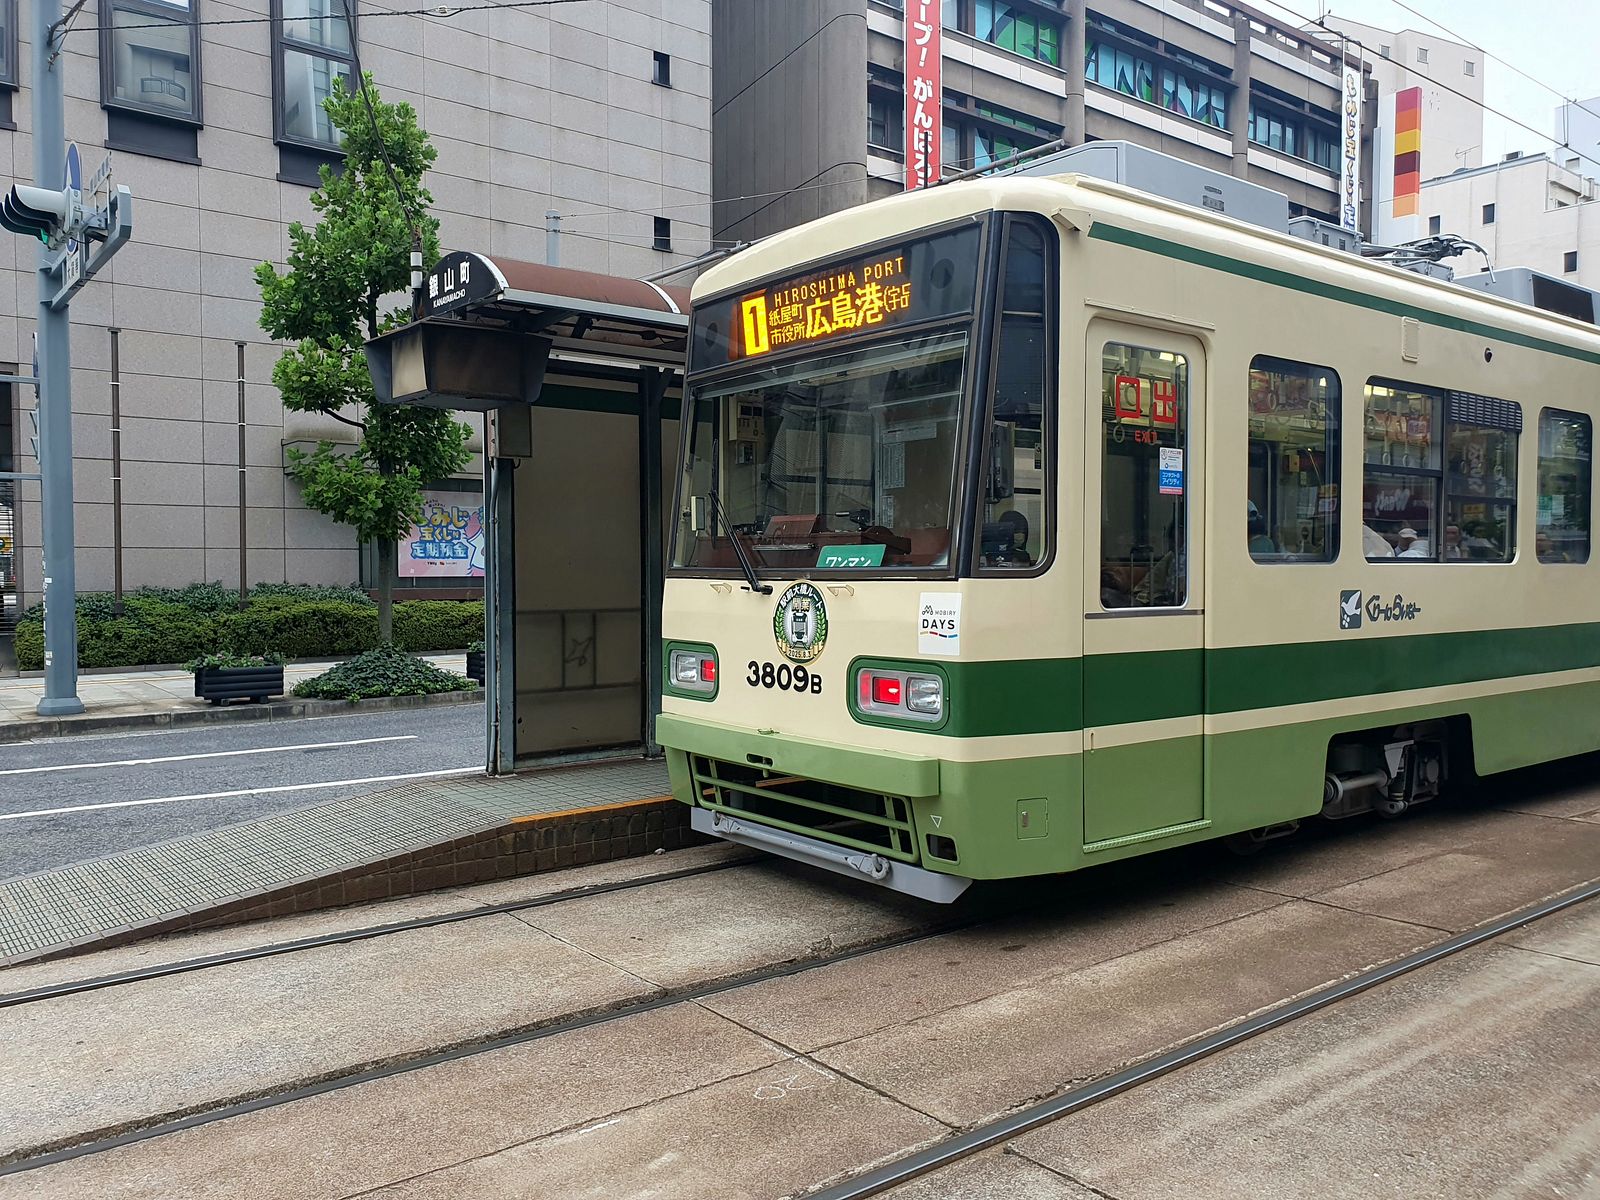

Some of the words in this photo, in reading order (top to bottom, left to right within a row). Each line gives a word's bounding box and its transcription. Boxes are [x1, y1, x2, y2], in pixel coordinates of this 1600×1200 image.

[429, 261, 470, 299] 銀山町
[774, 272, 856, 307] HIROSHIMA
[863, 257, 904, 283] PORT
[433, 289, 466, 308] KANAYAMACHO
[769, 303, 804, 327] 紙屋町
[770, 322, 807, 345] 市役所
[1135, 430, 1158, 443] EXIT
[411, 541, 468, 559] 定期預金
[825, 556, 871, 567] ワンマン
[779, 583, 823, 609] 駅前大橋ルート
[922, 619, 955, 630] DAYS
[746, 661, 823, 695] 3809B
